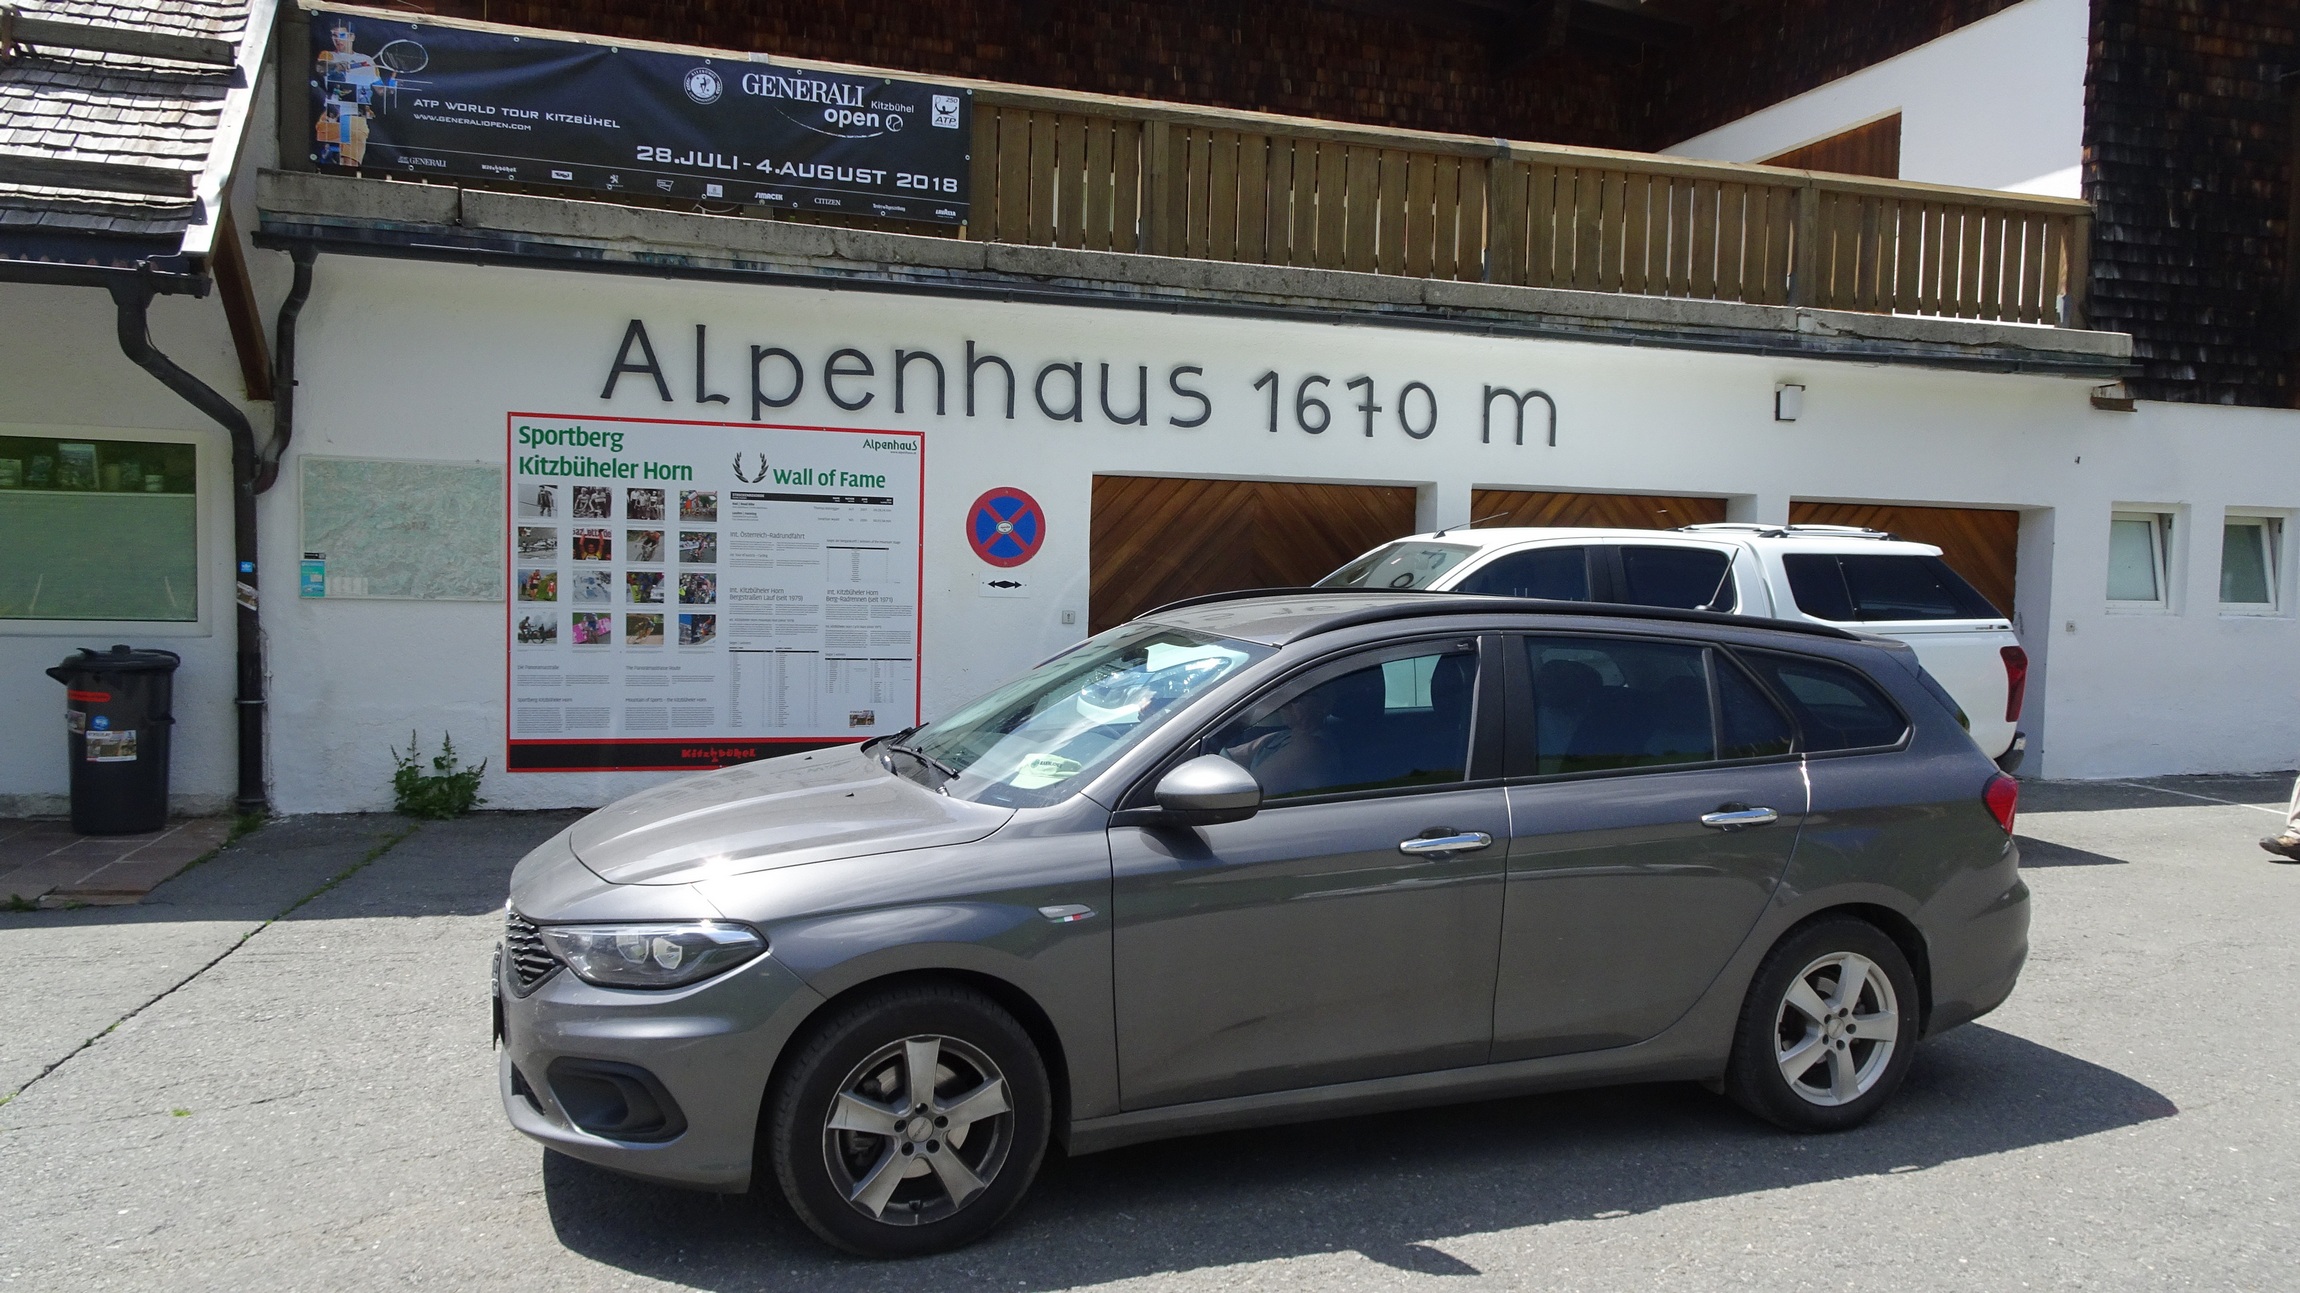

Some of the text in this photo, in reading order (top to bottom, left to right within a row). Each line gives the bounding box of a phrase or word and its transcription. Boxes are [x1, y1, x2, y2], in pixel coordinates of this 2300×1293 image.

[742, 72, 865, 108] GENERALI
[413, 99, 621, 129] ATP WORLD TOUR KITZBÜHEL
[823, 108, 880, 128] open
[870, 100, 915, 114] Kitzbühel
[935, 116, 957, 125] ATP
[409, 157, 447, 168] GENERALI
[636, 145, 738, 171] 28.JULI
[755, 159, 887, 186] 4.AUGUST
[896, 172, 958, 193] 2018
[814, 197, 842, 206] CITIZEN
[1253, 369, 1438, 440] 1670
[1482, 384, 1557, 448] m
[518, 426, 625, 453] Sportberg
[518, 455, 693, 481] Kitzbüheler Horn
[773, 468, 886, 488] Wall of Fame
